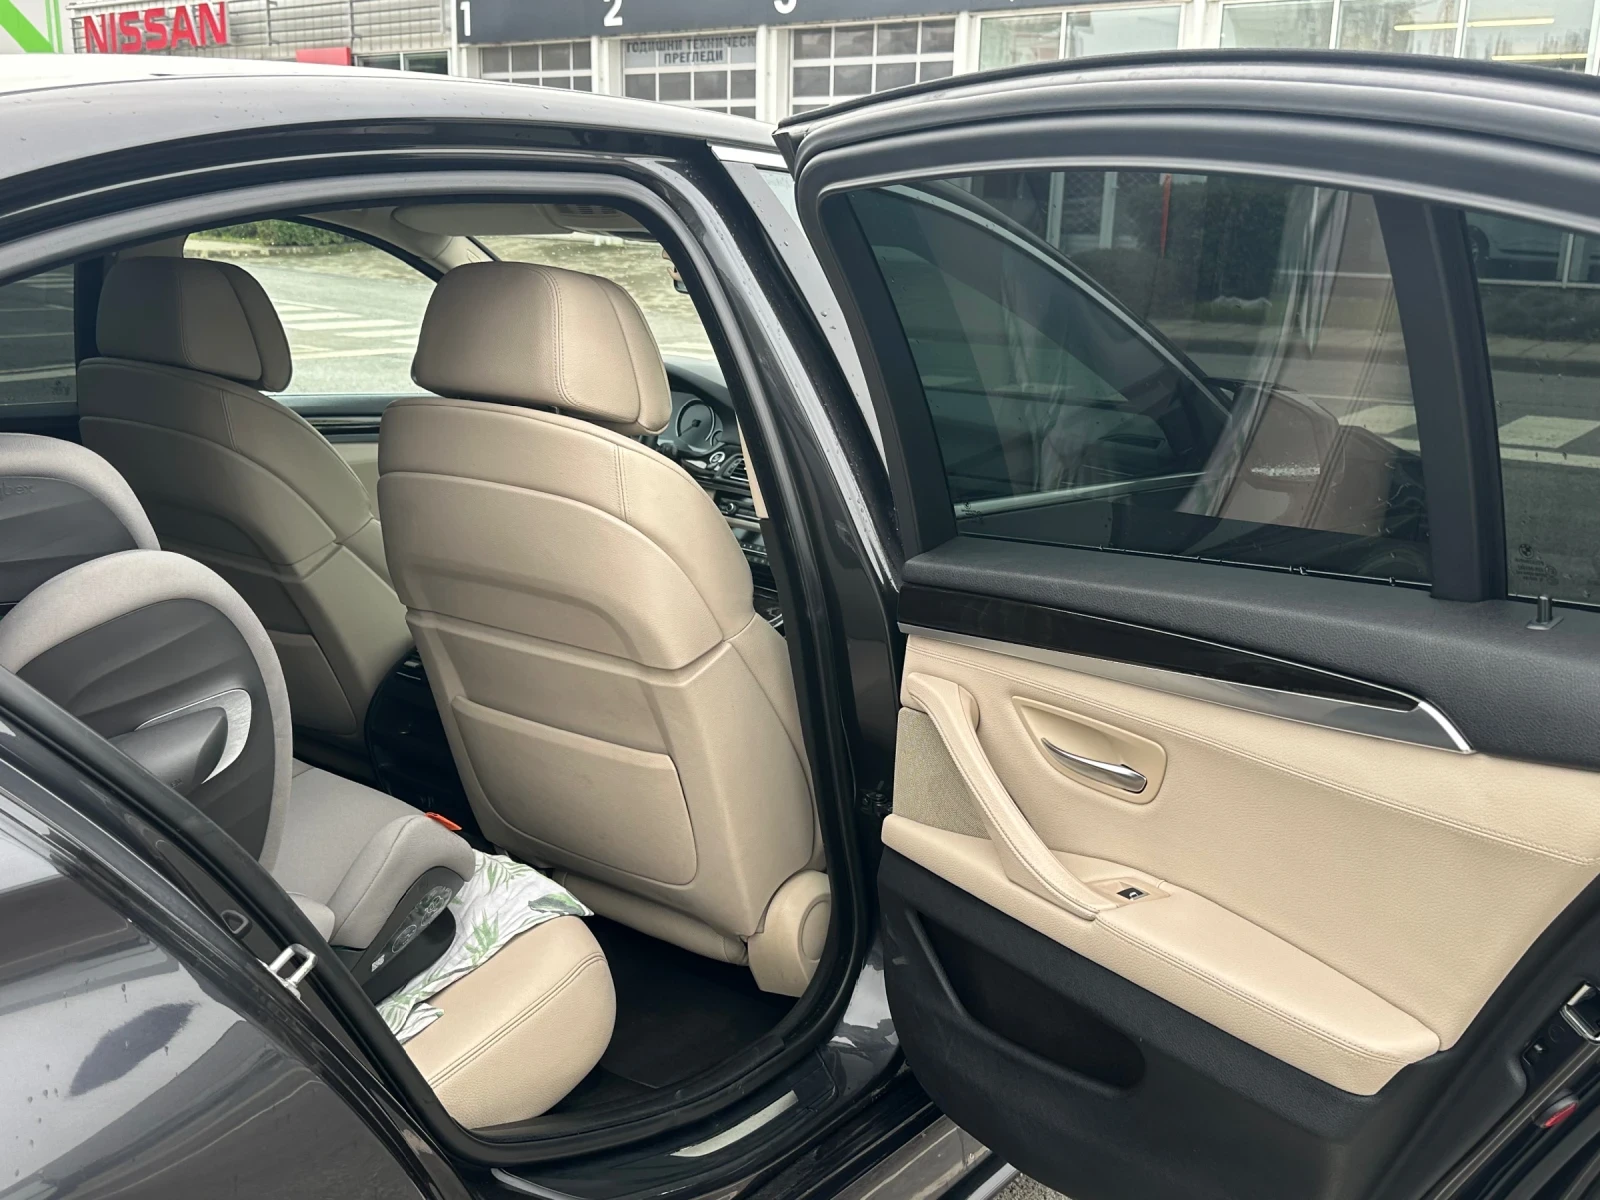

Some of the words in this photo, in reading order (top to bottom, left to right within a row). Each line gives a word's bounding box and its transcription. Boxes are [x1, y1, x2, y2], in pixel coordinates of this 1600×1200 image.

[460, 1, 471, 36] 1
[603, 0, 623, 26] 2
[83, 1, 226, 53] NISSAN
[626, 39, 682, 53] ГОДИШНИ
[664, 50, 723, 64] ПРЕГЛЕДИ
[0, 481, 35, 497] bex
